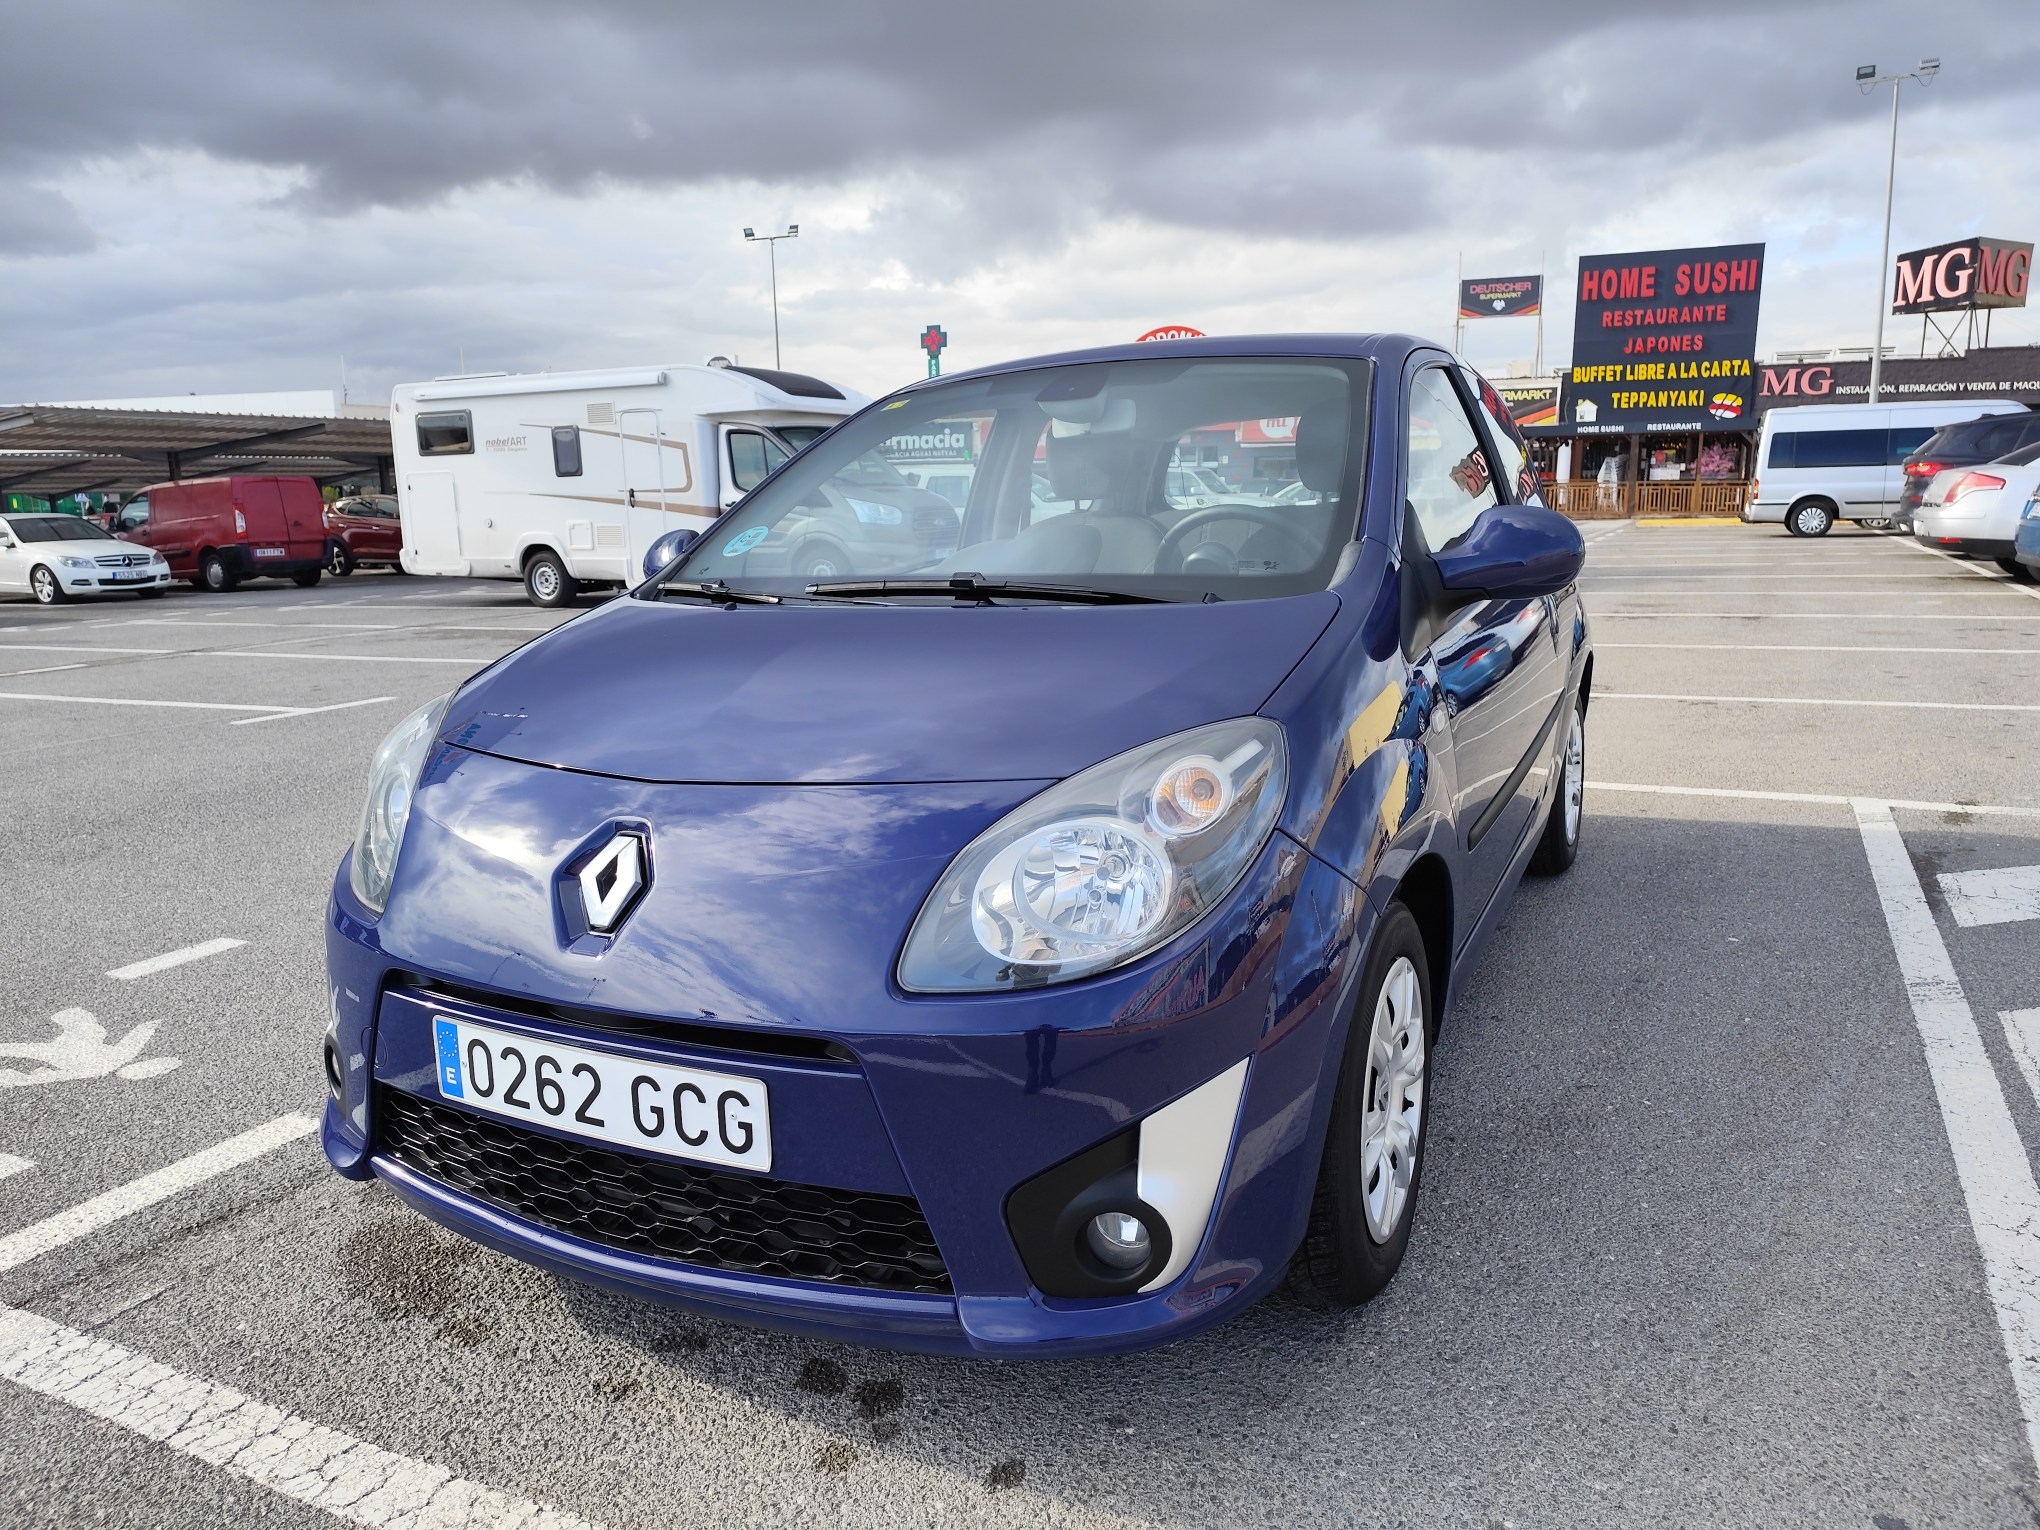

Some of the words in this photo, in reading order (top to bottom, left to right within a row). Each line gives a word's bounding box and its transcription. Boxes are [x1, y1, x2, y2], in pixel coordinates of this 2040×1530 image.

[1582, 266, 1656, 301] HOME
[1674, 259, 1758, 296] SUSHI
[1893, 247, 1974, 307] MG
[1976, 246, 2031, 298] MG
[1469, 281, 1532, 294] DEUTSCHER
[1479, 291, 1522, 300] SUPERMARKT
[1602, 304, 1727, 327] RESTAURANTE
[1623, 334, 1704, 354] JAPONES
[1573, 365, 1623, 383] BUFFET
[1626, 363, 1665, 380] LIBRE
[1667, 362, 1677, 379] A
[1680, 361, 1699, 378] LA
[1701, 359, 1751, 378] CARTA
[1759, 366, 1834, 396] MG
[1501, 389, 1553, 401] RMARKT
[1836, 382, 1897, 395] INSTALAÓN,
[1898, 381, 1957, 393] REPARACIÓN
[1959, 382, 1966, 391] Y
[1967, 381, 1997, 391] VENTA
[1999, 381, 2011, 391] DE
[1611, 389, 1705, 409] TEPPANYAKI
[1577, 425, 1599, 433] HOME
[1600, 425, 1624, 433] SUSHI
[1647, 422, 1702, 431] RESTAURANTE
[911, 449, 932, 457] AGUAS
[446, 1066, 457, 1085] E
[467, 1038, 605, 1127] 0262
[630, 1075, 754, 1154] GCG
